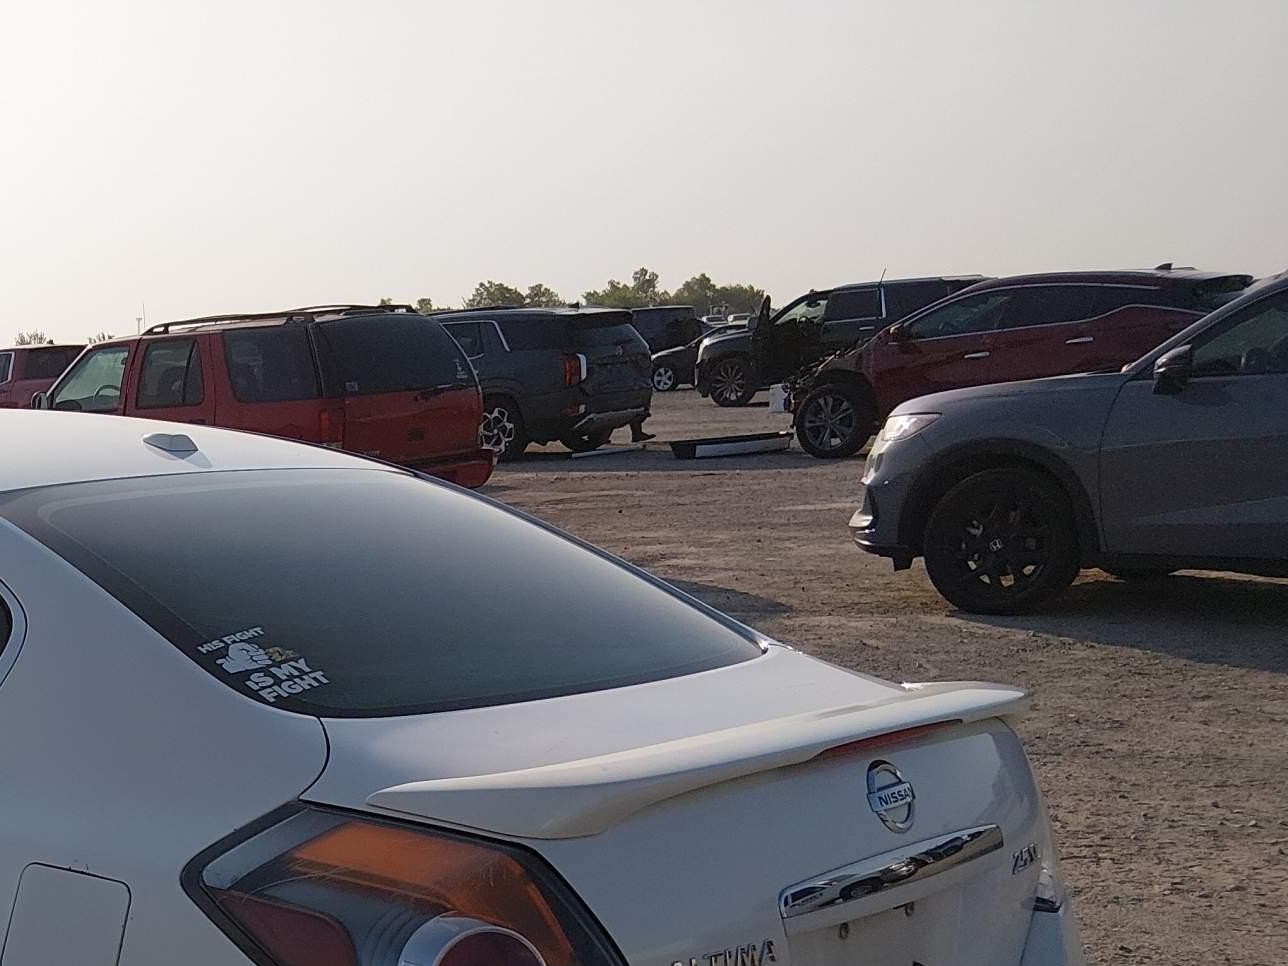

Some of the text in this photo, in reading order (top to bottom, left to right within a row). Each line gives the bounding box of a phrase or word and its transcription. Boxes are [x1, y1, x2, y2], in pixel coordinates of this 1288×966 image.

[197, 626, 264, 654] HIS FIGHT
[245, 658, 313, 691] IS MY
[258, 670, 330, 703] FIGHT
[877, 785, 912, 808] NISSAN
